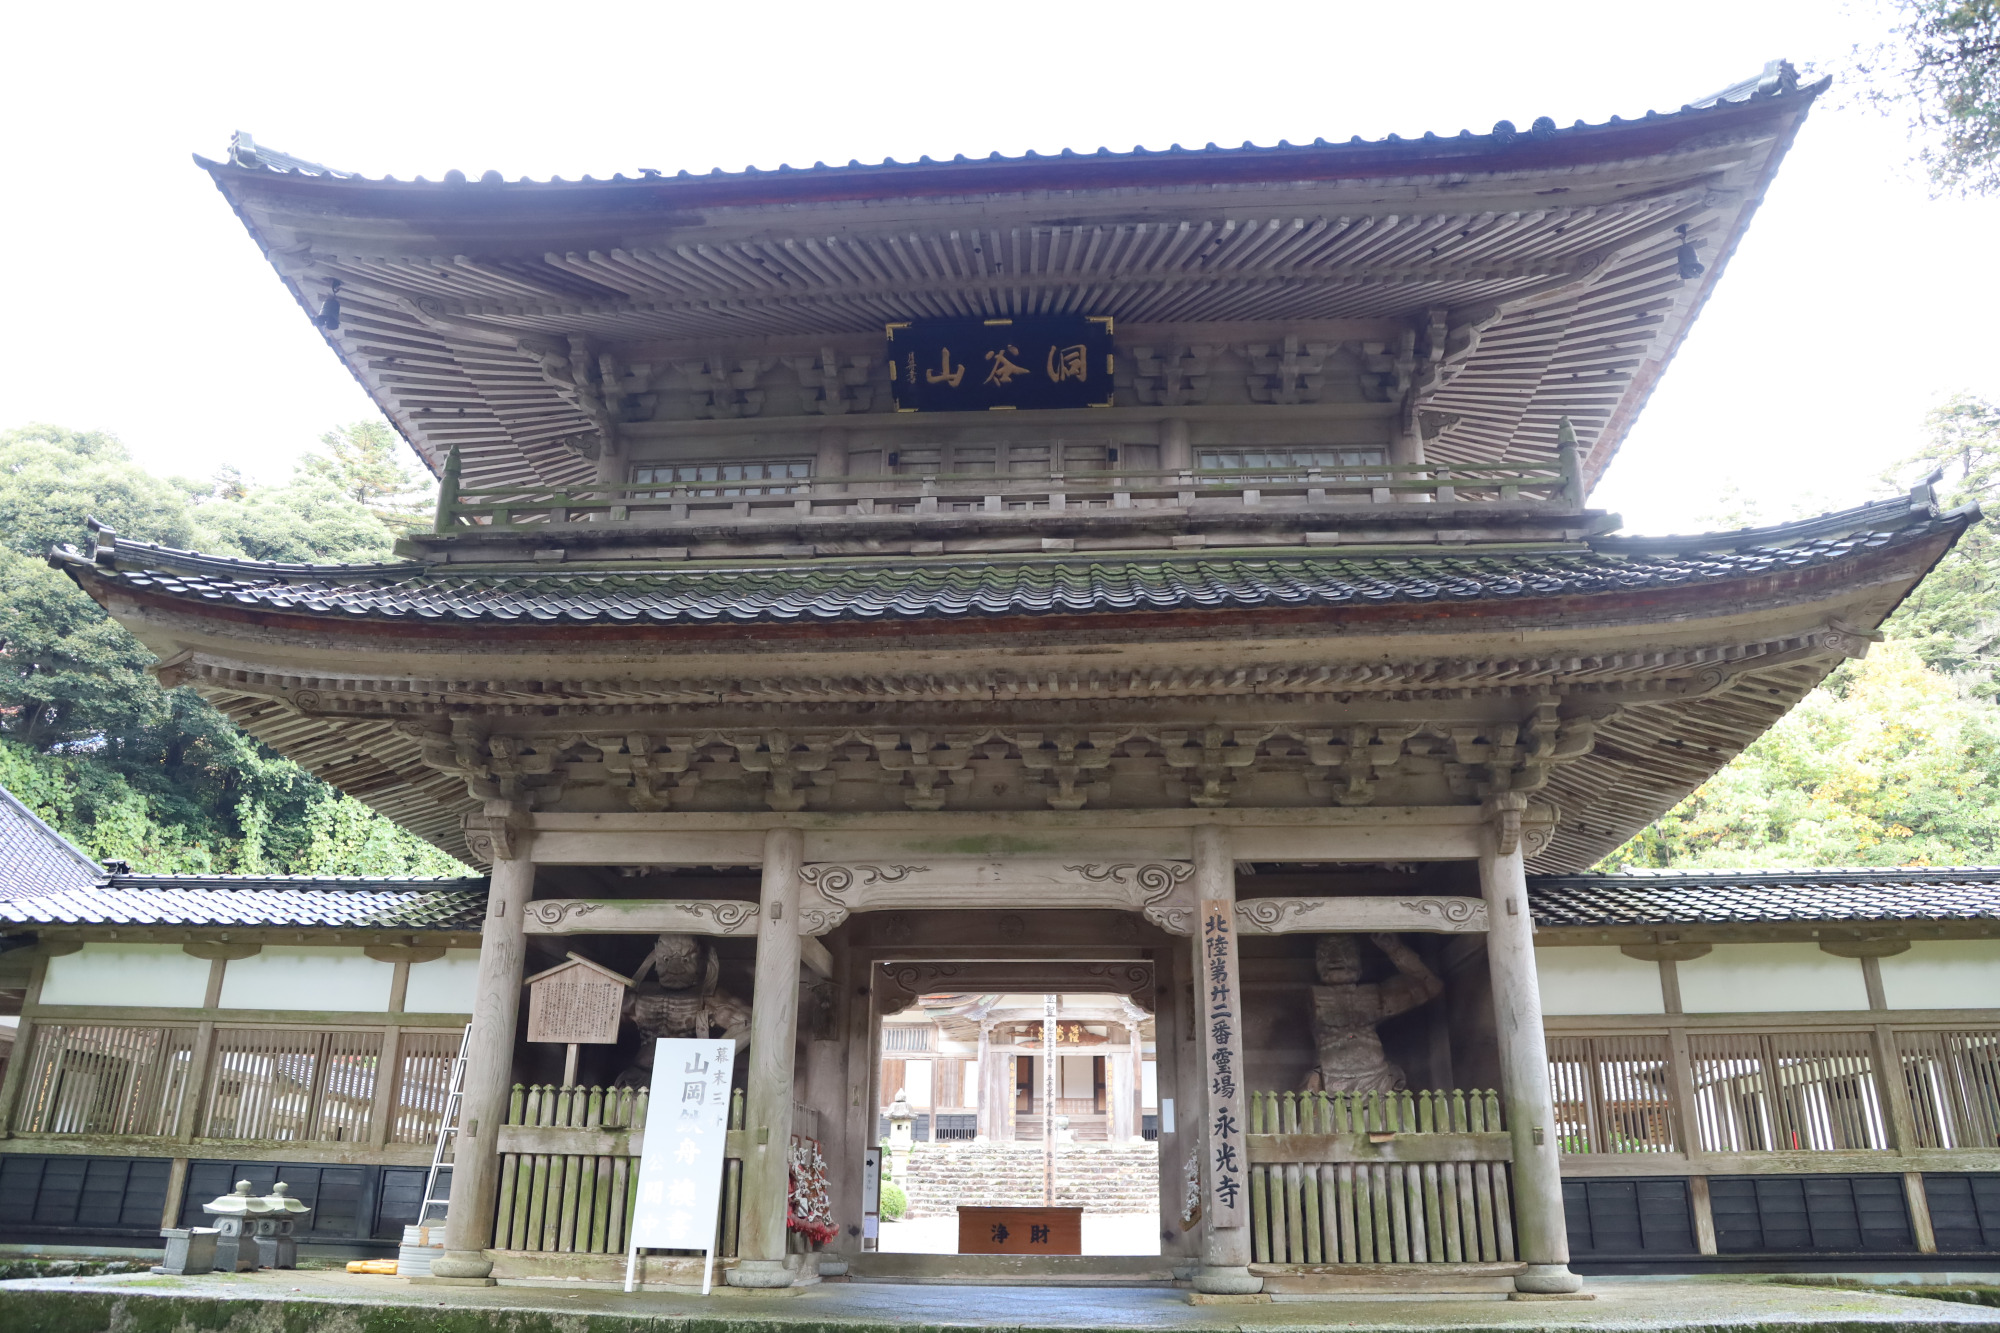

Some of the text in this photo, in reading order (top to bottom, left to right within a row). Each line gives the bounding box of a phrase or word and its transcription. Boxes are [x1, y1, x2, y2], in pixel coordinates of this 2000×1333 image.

[926, 344, 1087, 388] 洞谷山
[1213, 1107, 1241, 1209] 永光寺
[991, 1223, 1051, 1244] 浄財
